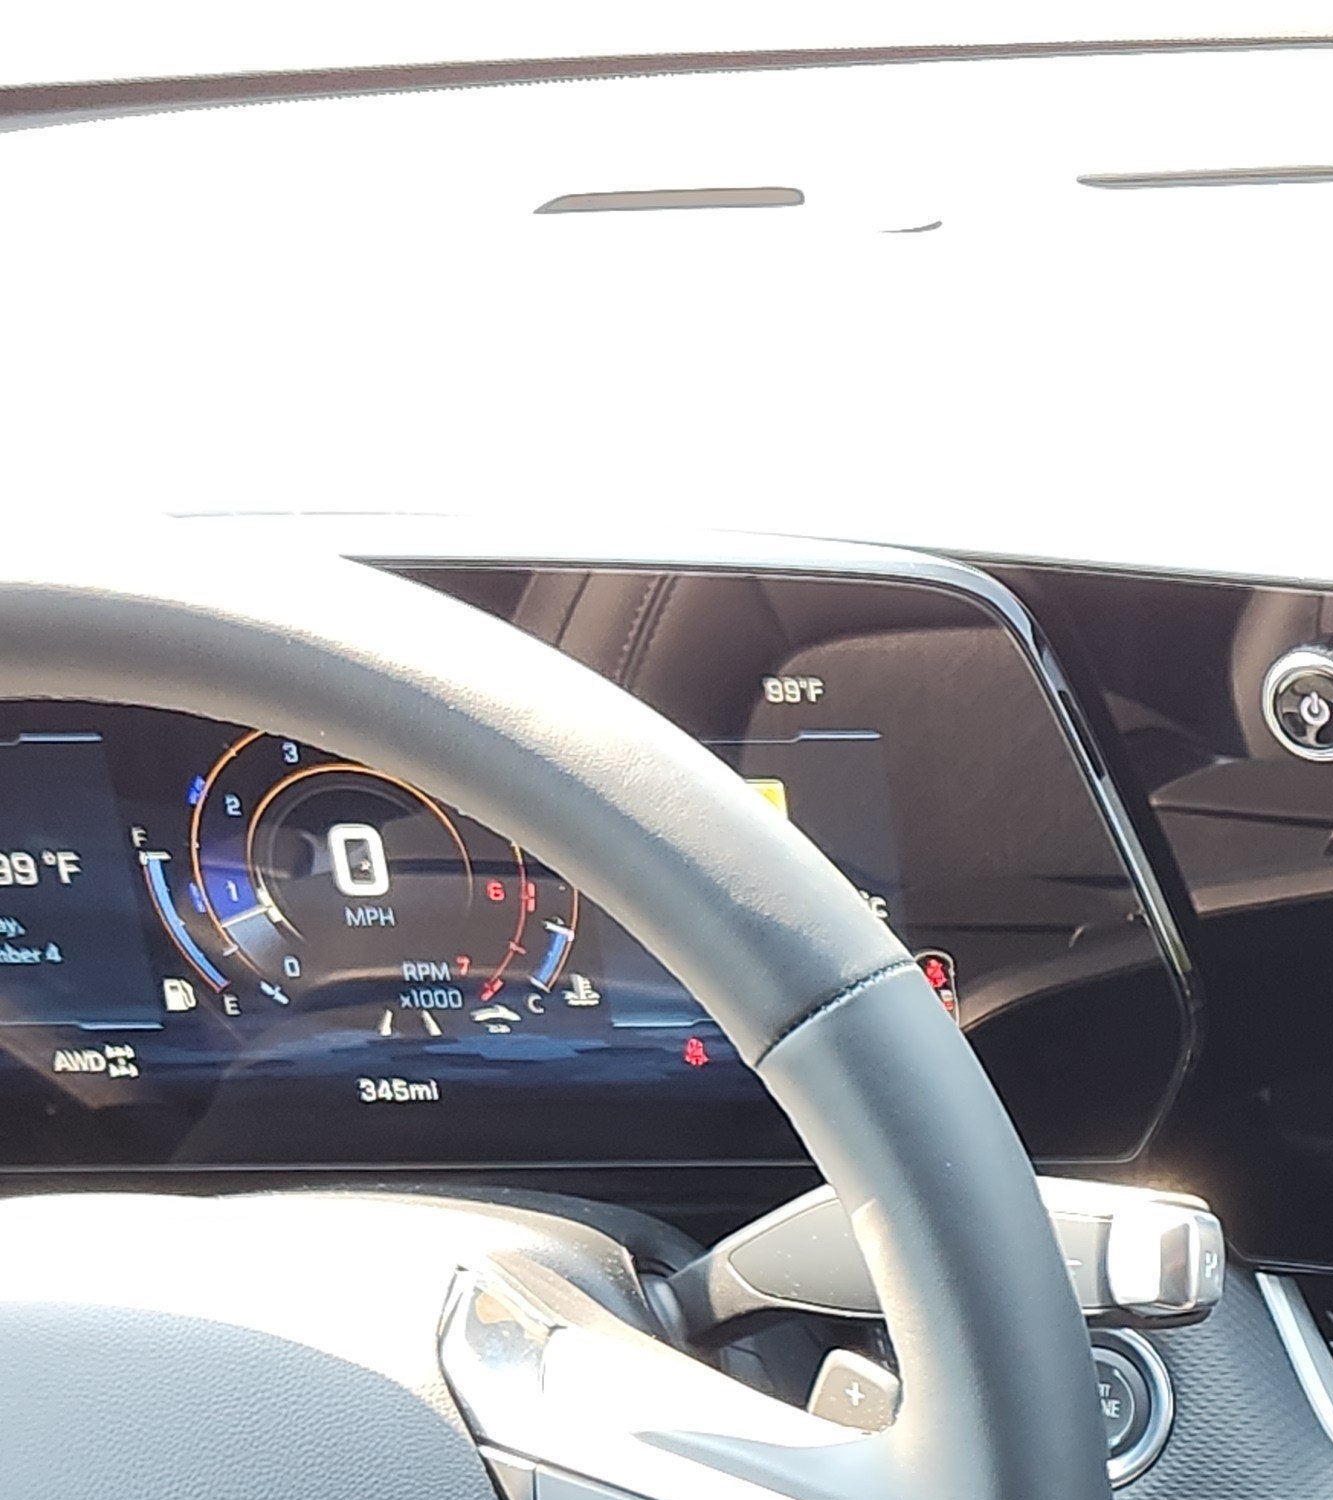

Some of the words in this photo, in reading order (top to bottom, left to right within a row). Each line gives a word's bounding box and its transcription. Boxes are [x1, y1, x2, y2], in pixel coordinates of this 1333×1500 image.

[282, 742, 299, 765] 3
[224, 794, 242, 817] 2
[131, 826, 147, 848] F
[328, 823, 390, 897] 0
[227, 880, 239, 902] 1
[344, 906, 396, 927] MPH
[402, 961, 451, 982] RPM
[223, 995, 241, 1016] E
[400, 987, 464, 1010] x1000
[527, 994, 545, 1014] C
[53, 1050, 106, 1073] AWD
[358, 1077, 440, 1103] 345mi
